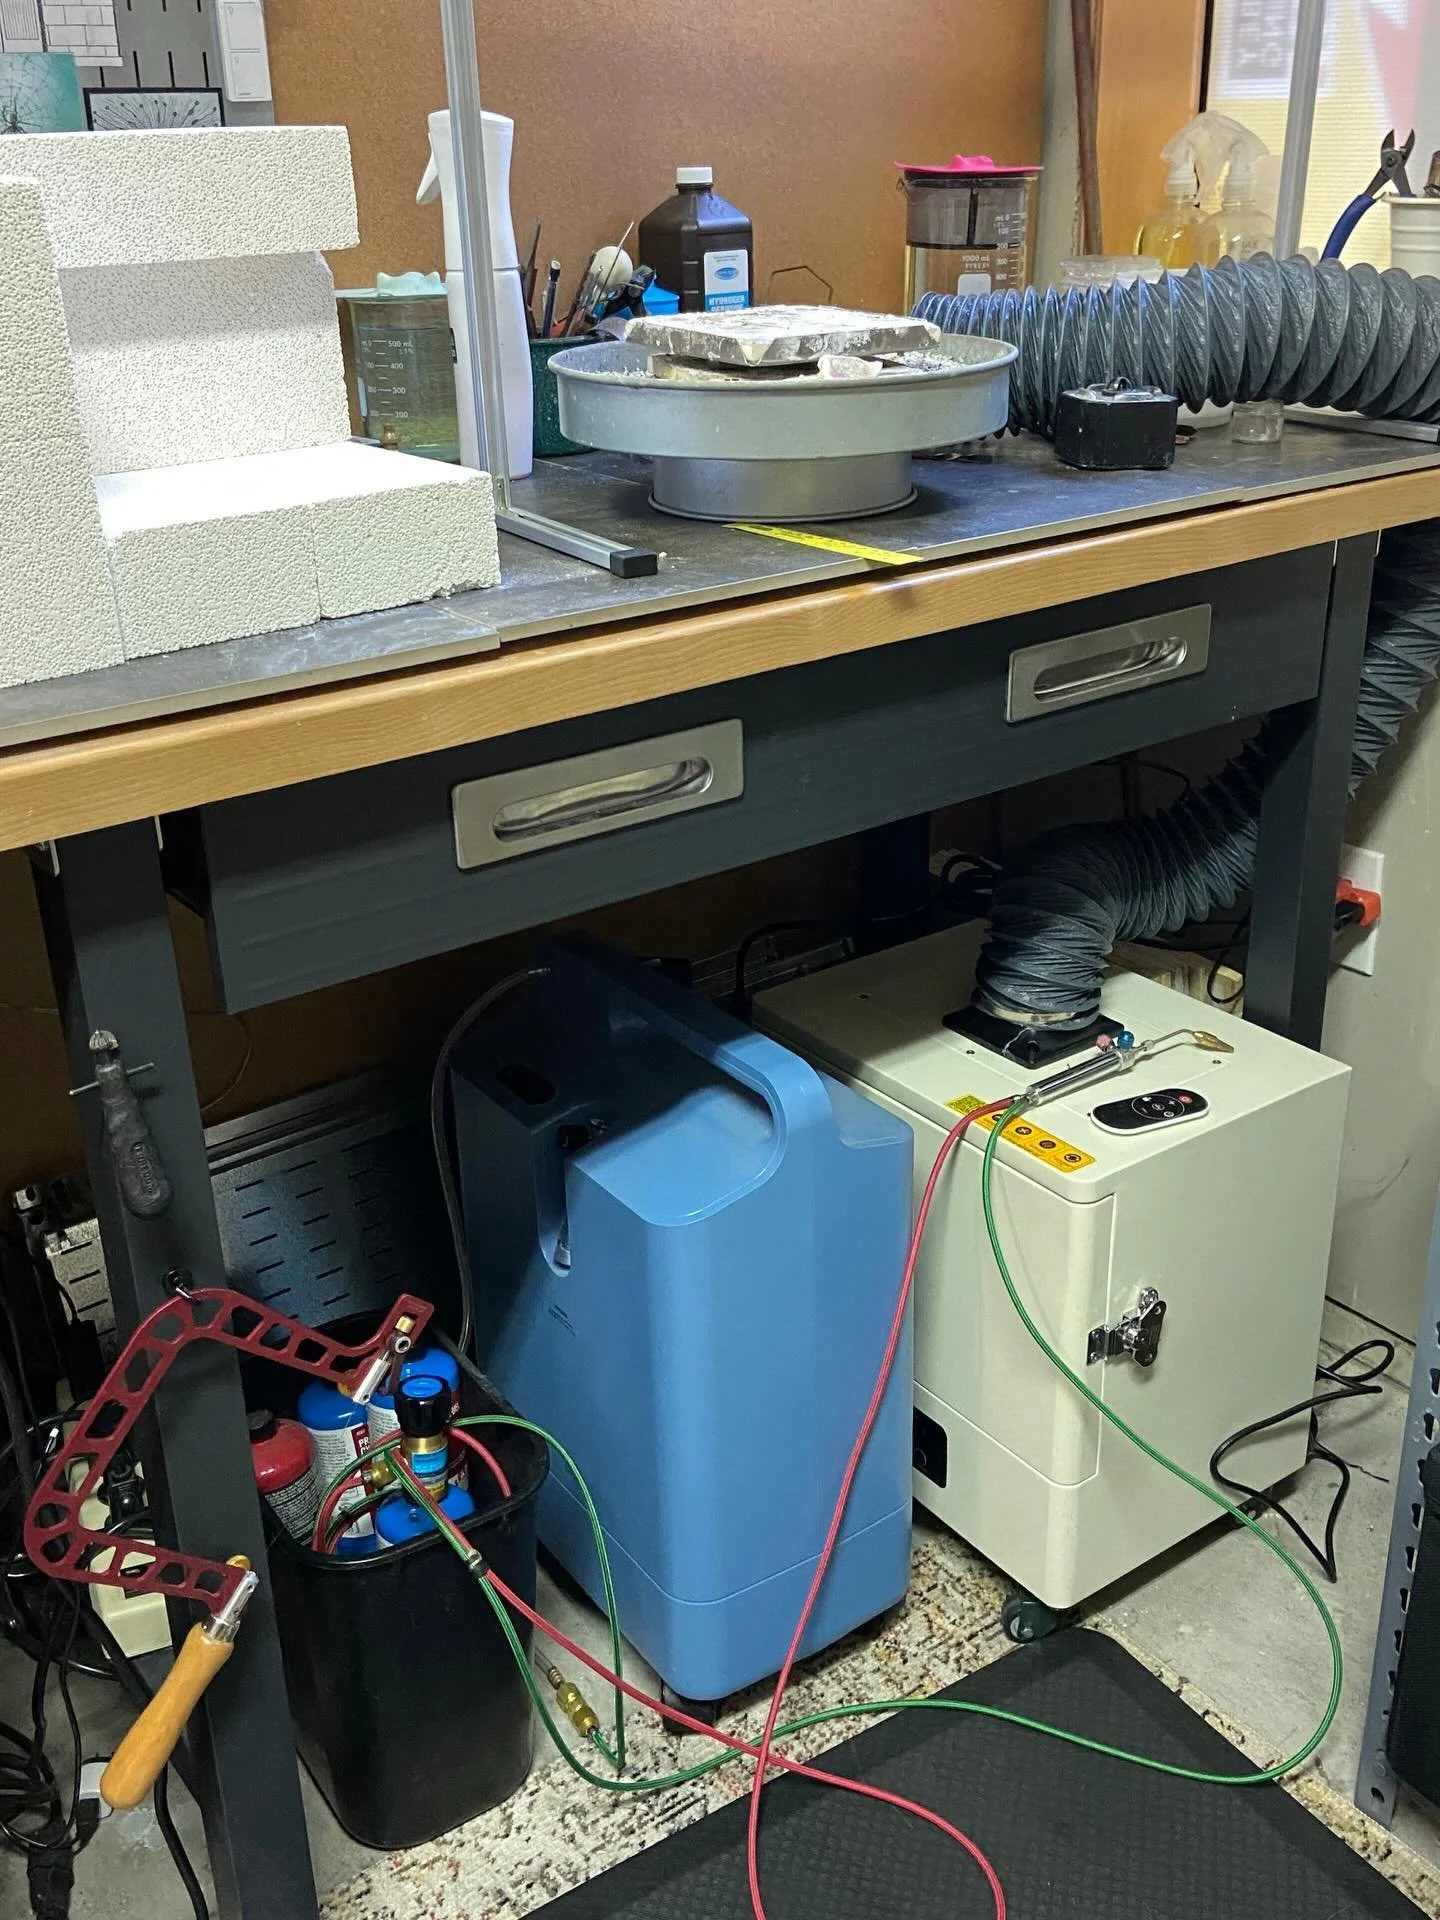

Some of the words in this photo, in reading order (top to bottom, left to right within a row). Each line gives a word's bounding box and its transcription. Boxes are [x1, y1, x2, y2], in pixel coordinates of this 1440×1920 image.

[997, 242, 1008, 250] 200
[962, 254, 980, 262] 1000
[388, 340, 401, 348] 500
[392, 386, 406, 395] 300
[358, 1436, 370, 1448] PR
